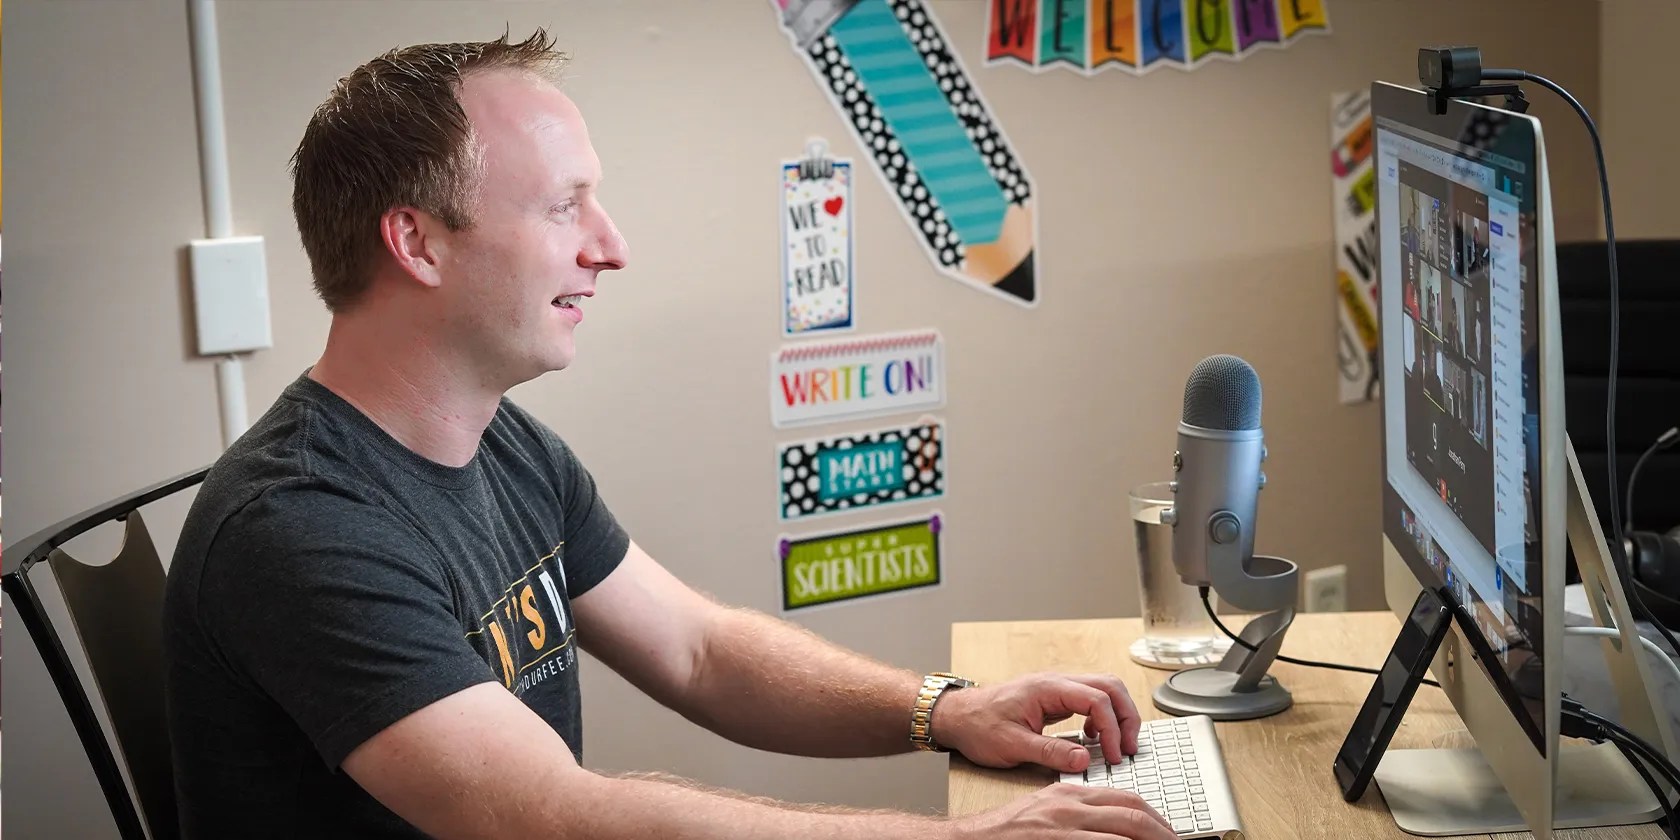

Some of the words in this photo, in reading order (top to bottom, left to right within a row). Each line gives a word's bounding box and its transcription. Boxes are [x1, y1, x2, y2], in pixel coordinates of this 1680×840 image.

[790, 202, 820, 230] WE
[805, 236, 826, 257] TO
[795, 259, 844, 295] READ
[781, 365, 873, 406] WRITE
[885, 356, 932, 395] ON!
[829, 450, 894, 486] MATH
[825, 536, 896, 555] SUPER
[794, 545, 929, 597] SCIENTISTS
